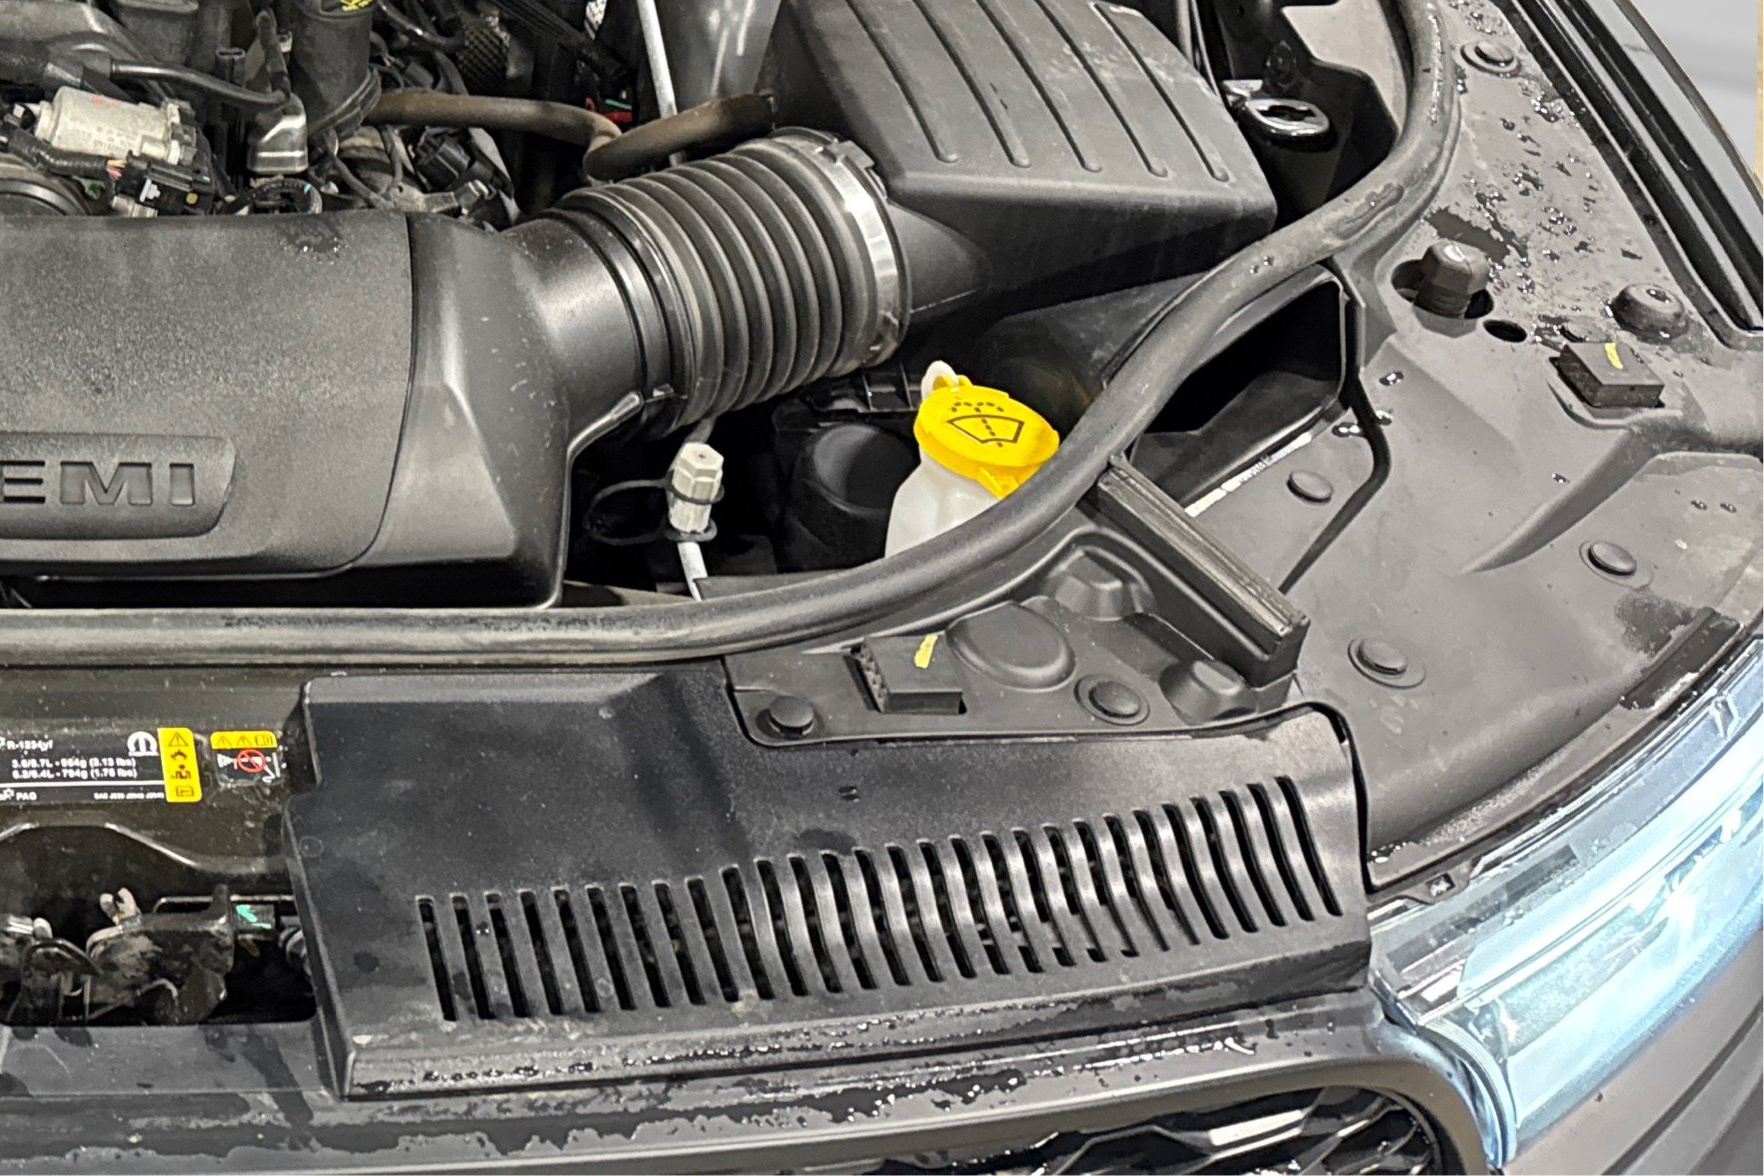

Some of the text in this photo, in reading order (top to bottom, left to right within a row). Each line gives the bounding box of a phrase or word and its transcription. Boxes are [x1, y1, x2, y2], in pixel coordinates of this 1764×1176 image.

[7, 739, 53, 752] R-1234yf
[116, 757, 136, 768] lbs)
[116, 768, 138, 779] lbs)
[16, 791, 37, 801] PAG
